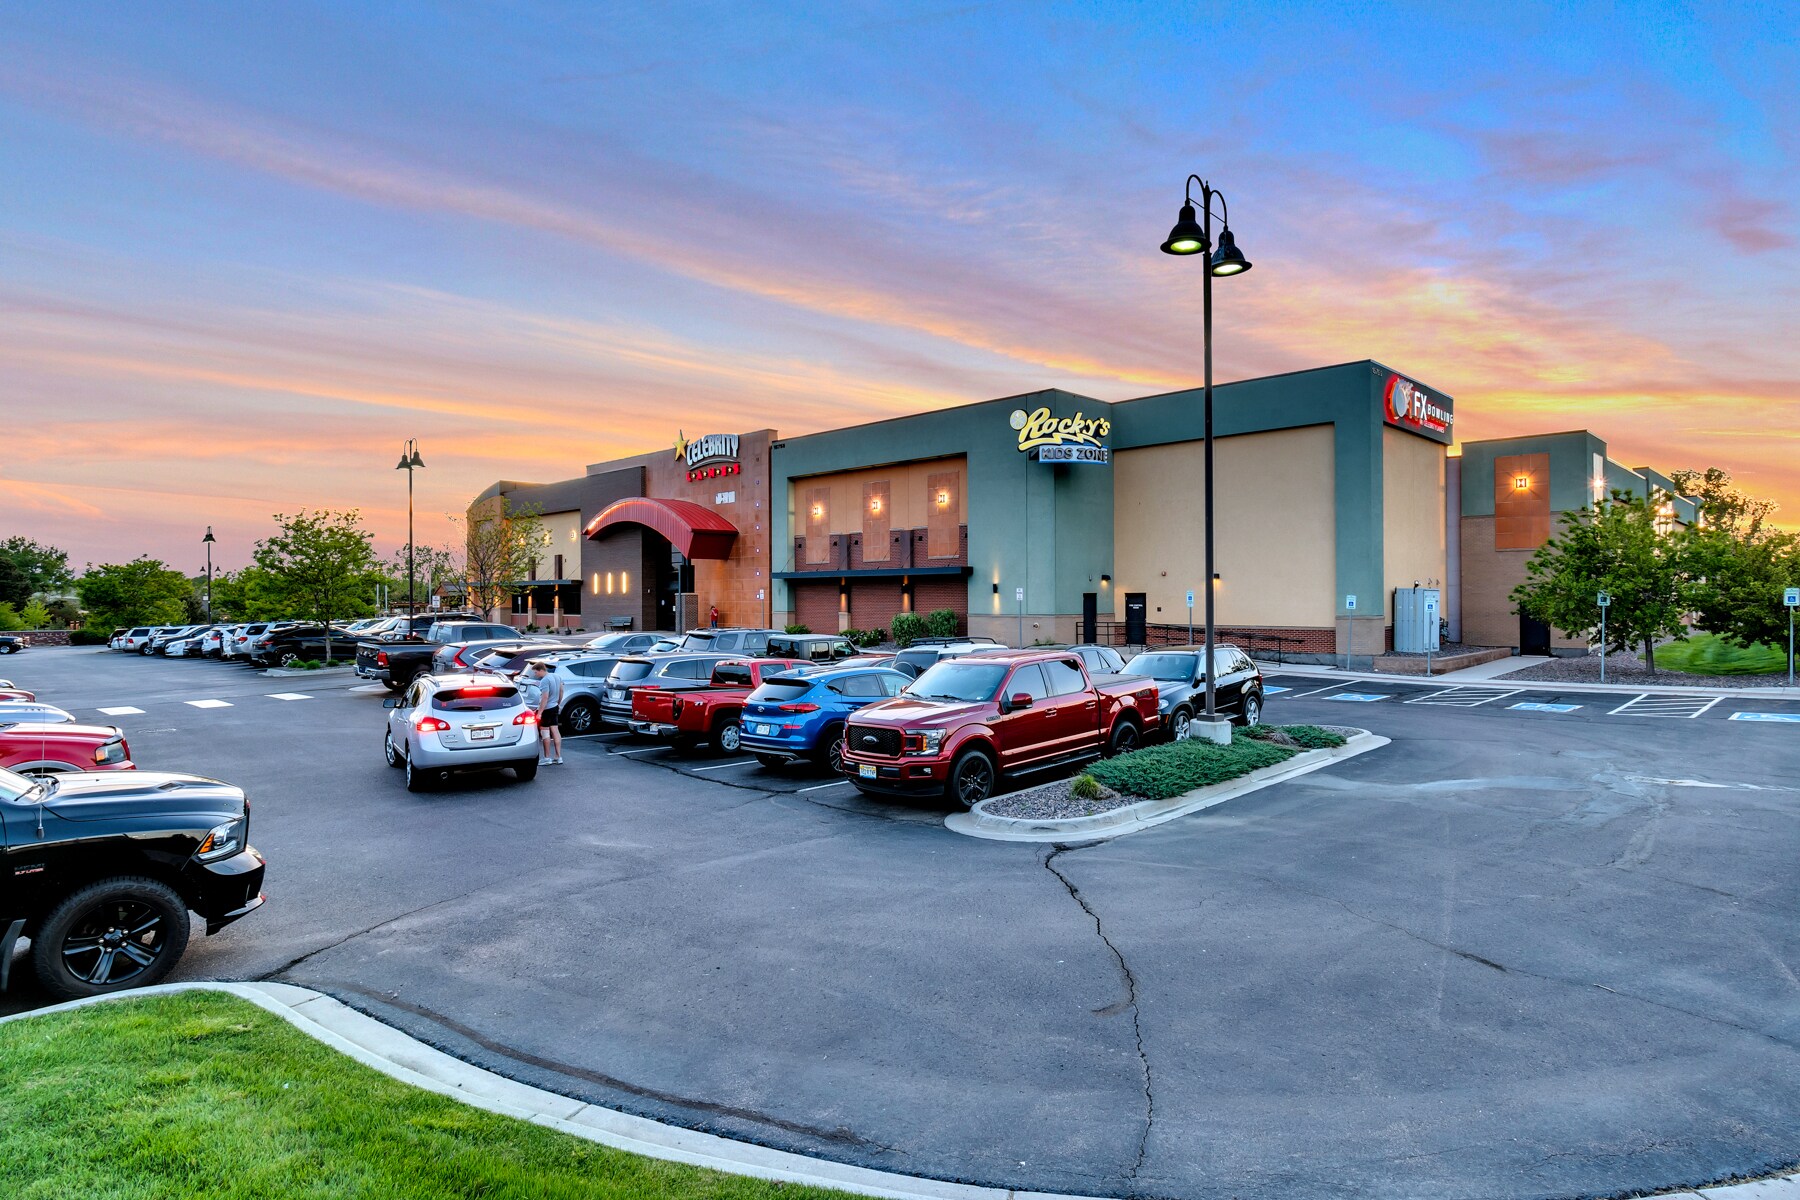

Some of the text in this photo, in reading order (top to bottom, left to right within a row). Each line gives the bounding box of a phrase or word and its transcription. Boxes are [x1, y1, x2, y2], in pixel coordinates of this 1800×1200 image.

[1414, 391, 1427, 421] FX
[1427, 404, 1453, 425] BOWLING
[1018, 407, 1111, 443] Rocky's
[686, 433, 739, 466] CELEBRITY
[1041, 447, 1108, 462] KIDS ZONE
